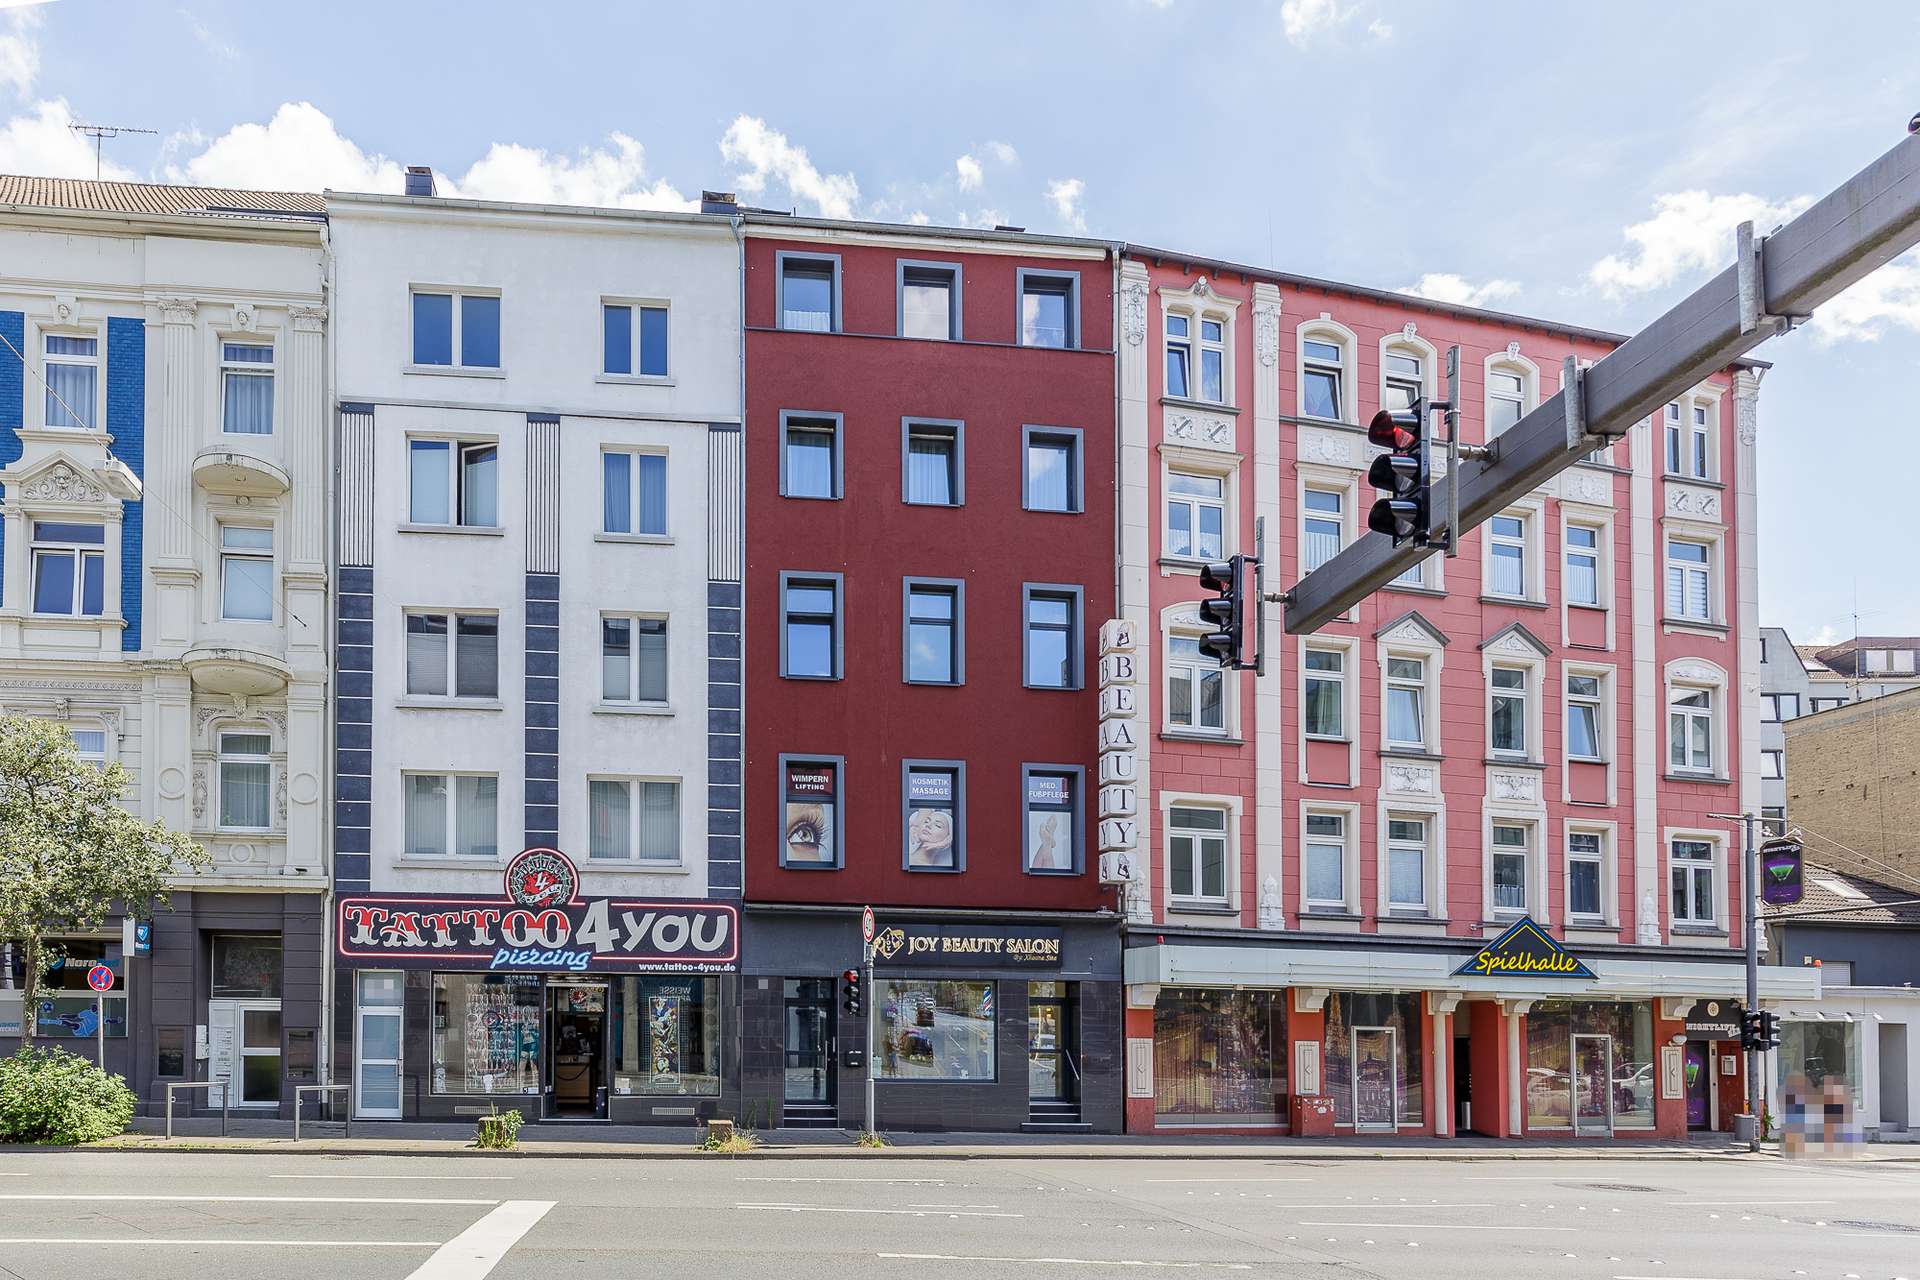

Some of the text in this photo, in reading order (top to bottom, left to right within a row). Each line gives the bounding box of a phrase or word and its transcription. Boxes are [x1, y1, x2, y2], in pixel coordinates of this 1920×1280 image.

[1113, 656, 1135, 845] BEAUTY
[791, 774, 829, 783] WIMPERN
[912, 777, 949, 786] KOSMETIK
[912, 787, 949, 795] MASSAGE
[517, 859, 562, 875] TATTOO
[534, 872, 550, 890] 4
[345, 905, 571, 948] TATTOO
[908, 937, 1059, 955] JOY BEAUTY SALON
[490, 948, 592, 970] piercing
[638, 962, 736, 972] www.tattoo-4you.de
[1476, 951, 1578, 975] Spielhalle
